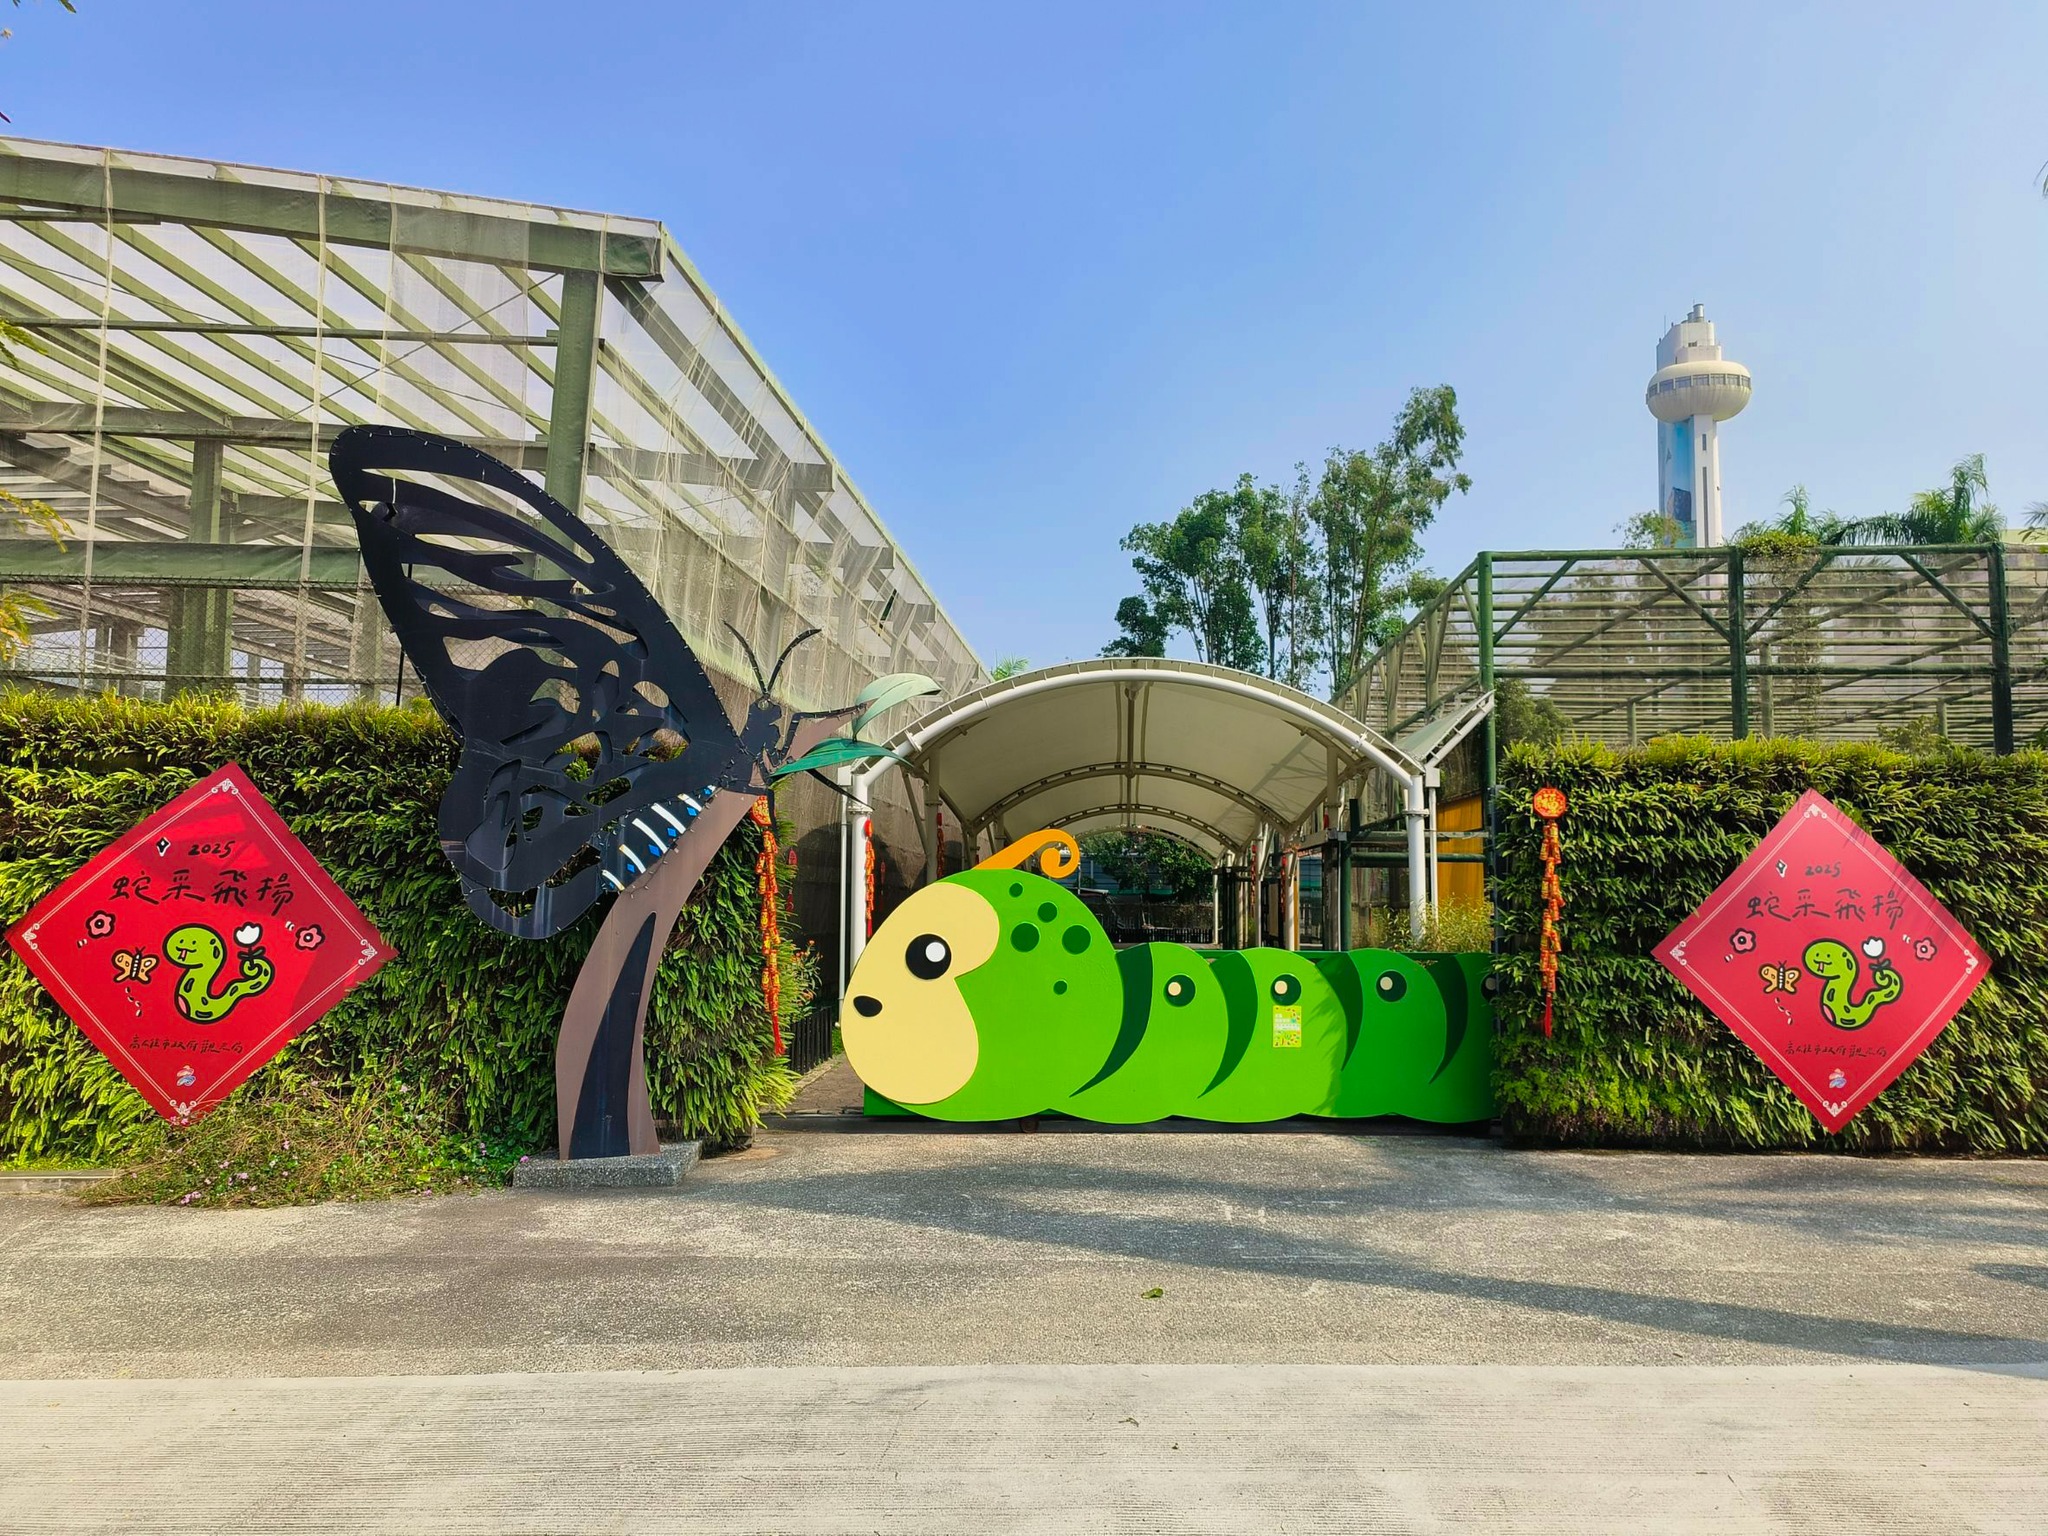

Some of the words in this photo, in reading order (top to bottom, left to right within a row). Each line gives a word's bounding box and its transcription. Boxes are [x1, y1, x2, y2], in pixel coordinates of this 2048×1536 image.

[188, 840, 236, 859] 2025
[1804, 862, 1841, 878] 2025
[109, 869, 294, 917] 蛇采飛揚
[1746, 888, 1904, 930] 蛇采飛揚
